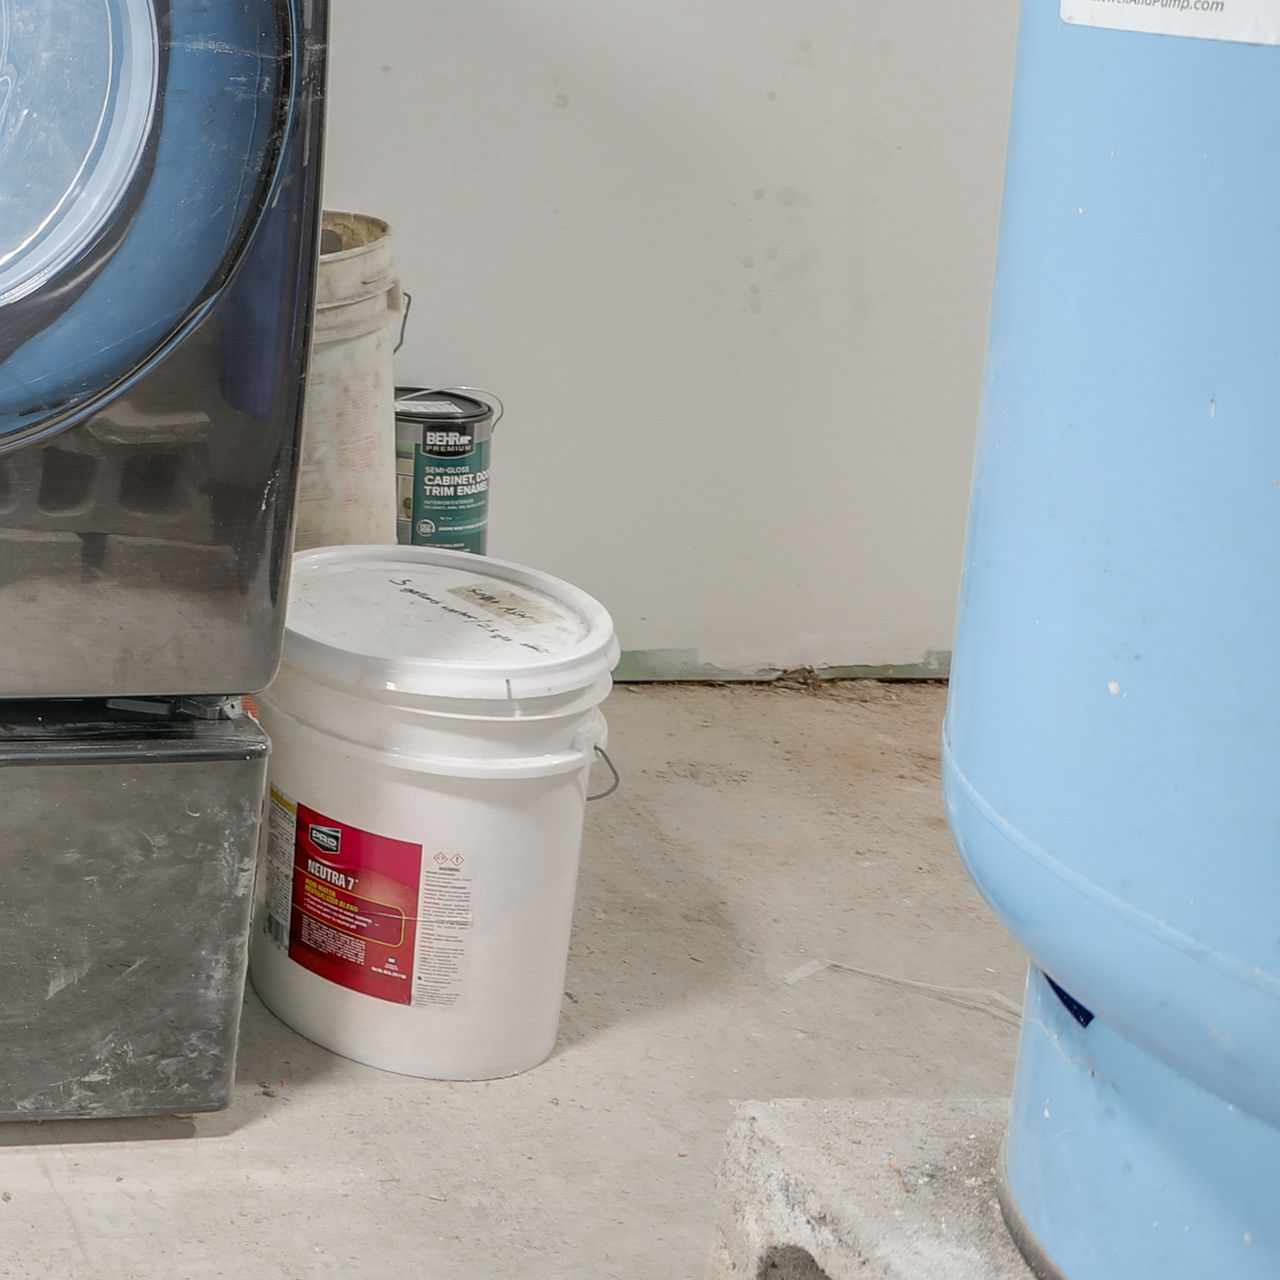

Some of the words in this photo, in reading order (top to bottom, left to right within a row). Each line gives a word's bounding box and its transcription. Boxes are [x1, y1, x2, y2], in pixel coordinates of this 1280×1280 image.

[426, 432, 460, 445] BEHR
[424, 473, 475, 486] CABINET,
[424, 486, 454, 496] TRIM
[312, 830, 337, 846] PRO
[308, 859, 345, 890] NEUTRA
